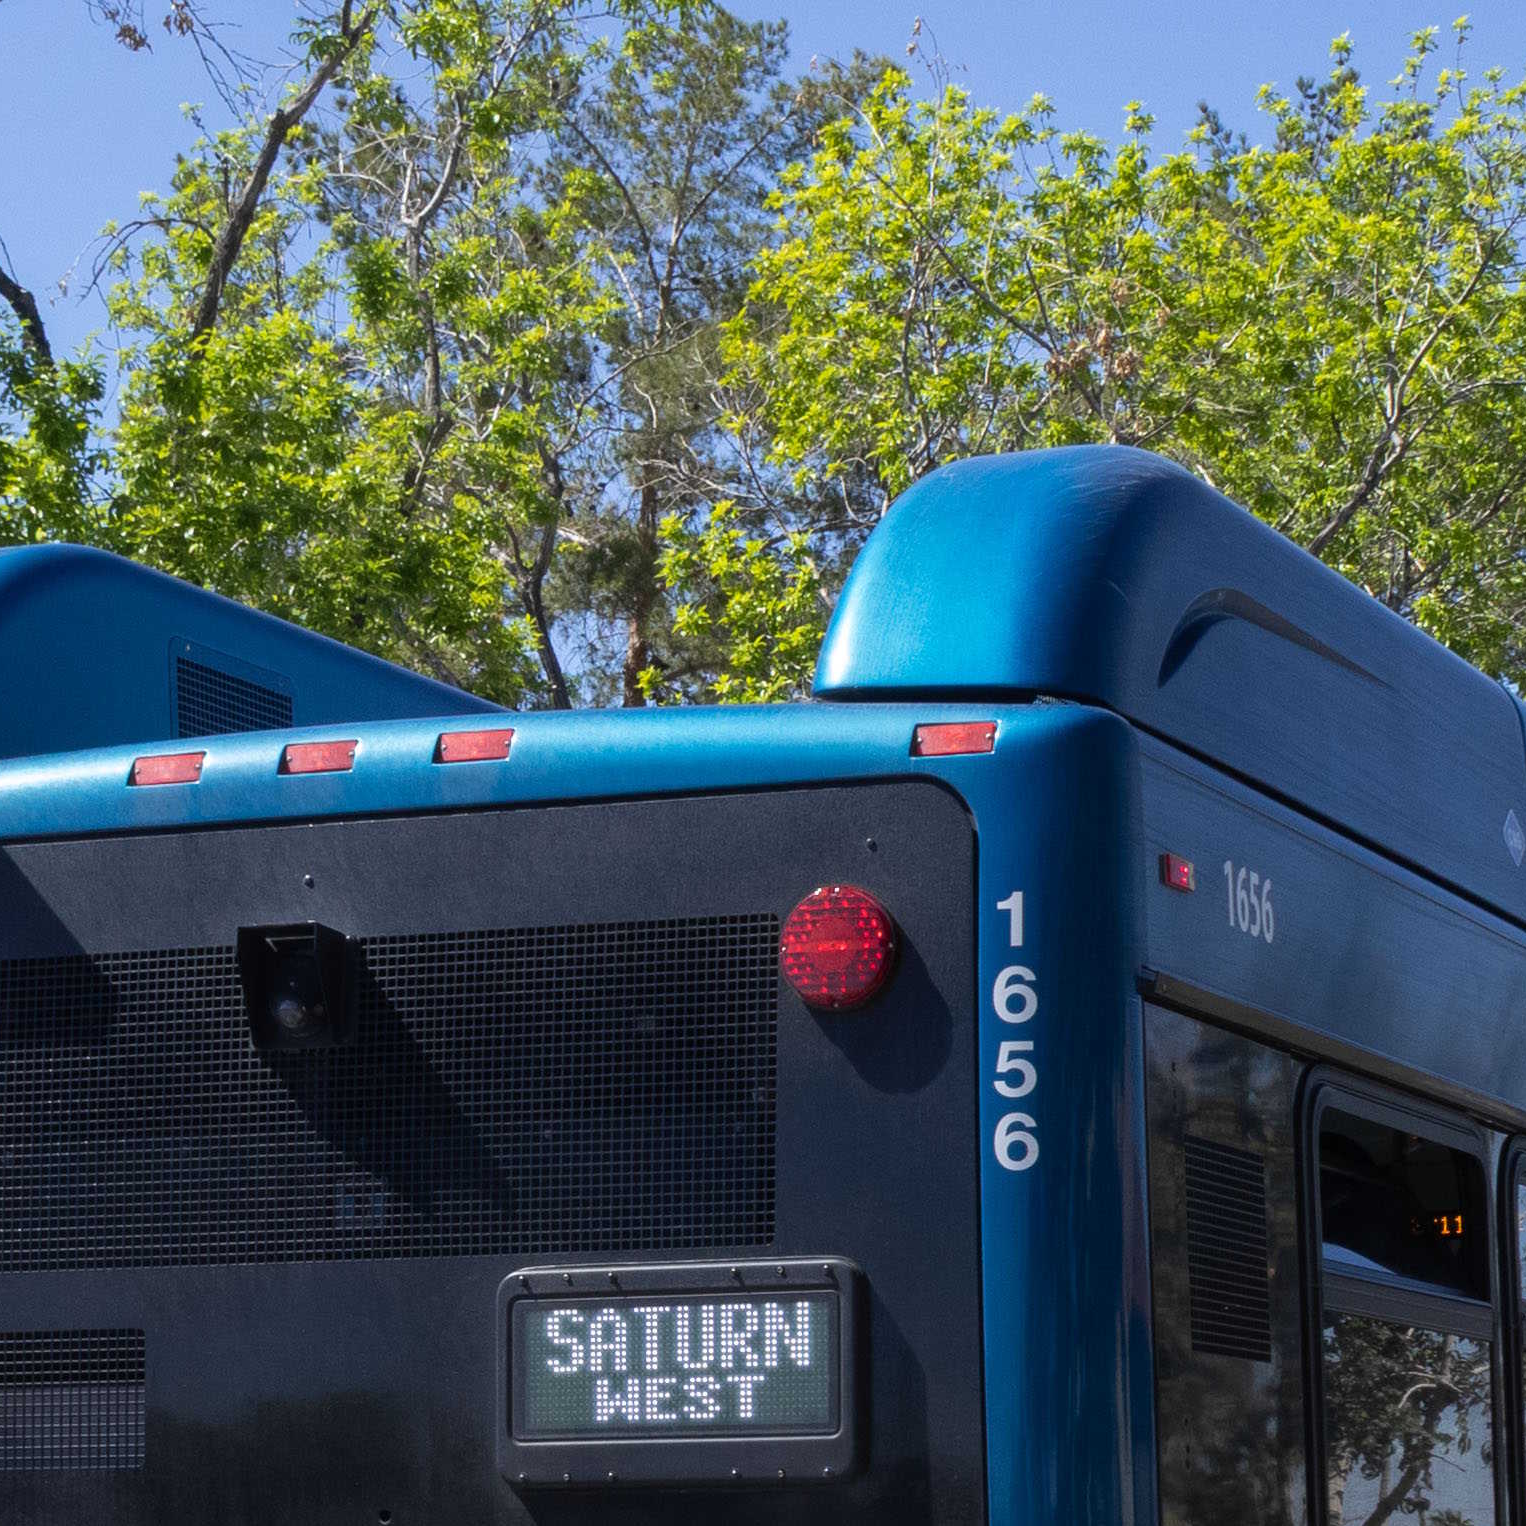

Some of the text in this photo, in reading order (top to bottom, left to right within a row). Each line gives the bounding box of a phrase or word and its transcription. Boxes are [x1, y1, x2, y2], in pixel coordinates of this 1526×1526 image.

[1222, 859, 1275, 944] 1656
[992, 890, 1040, 1172] 1656
[546, 1301, 810, 1374] SATURN
[594, 1375, 765, 1422] WEST
